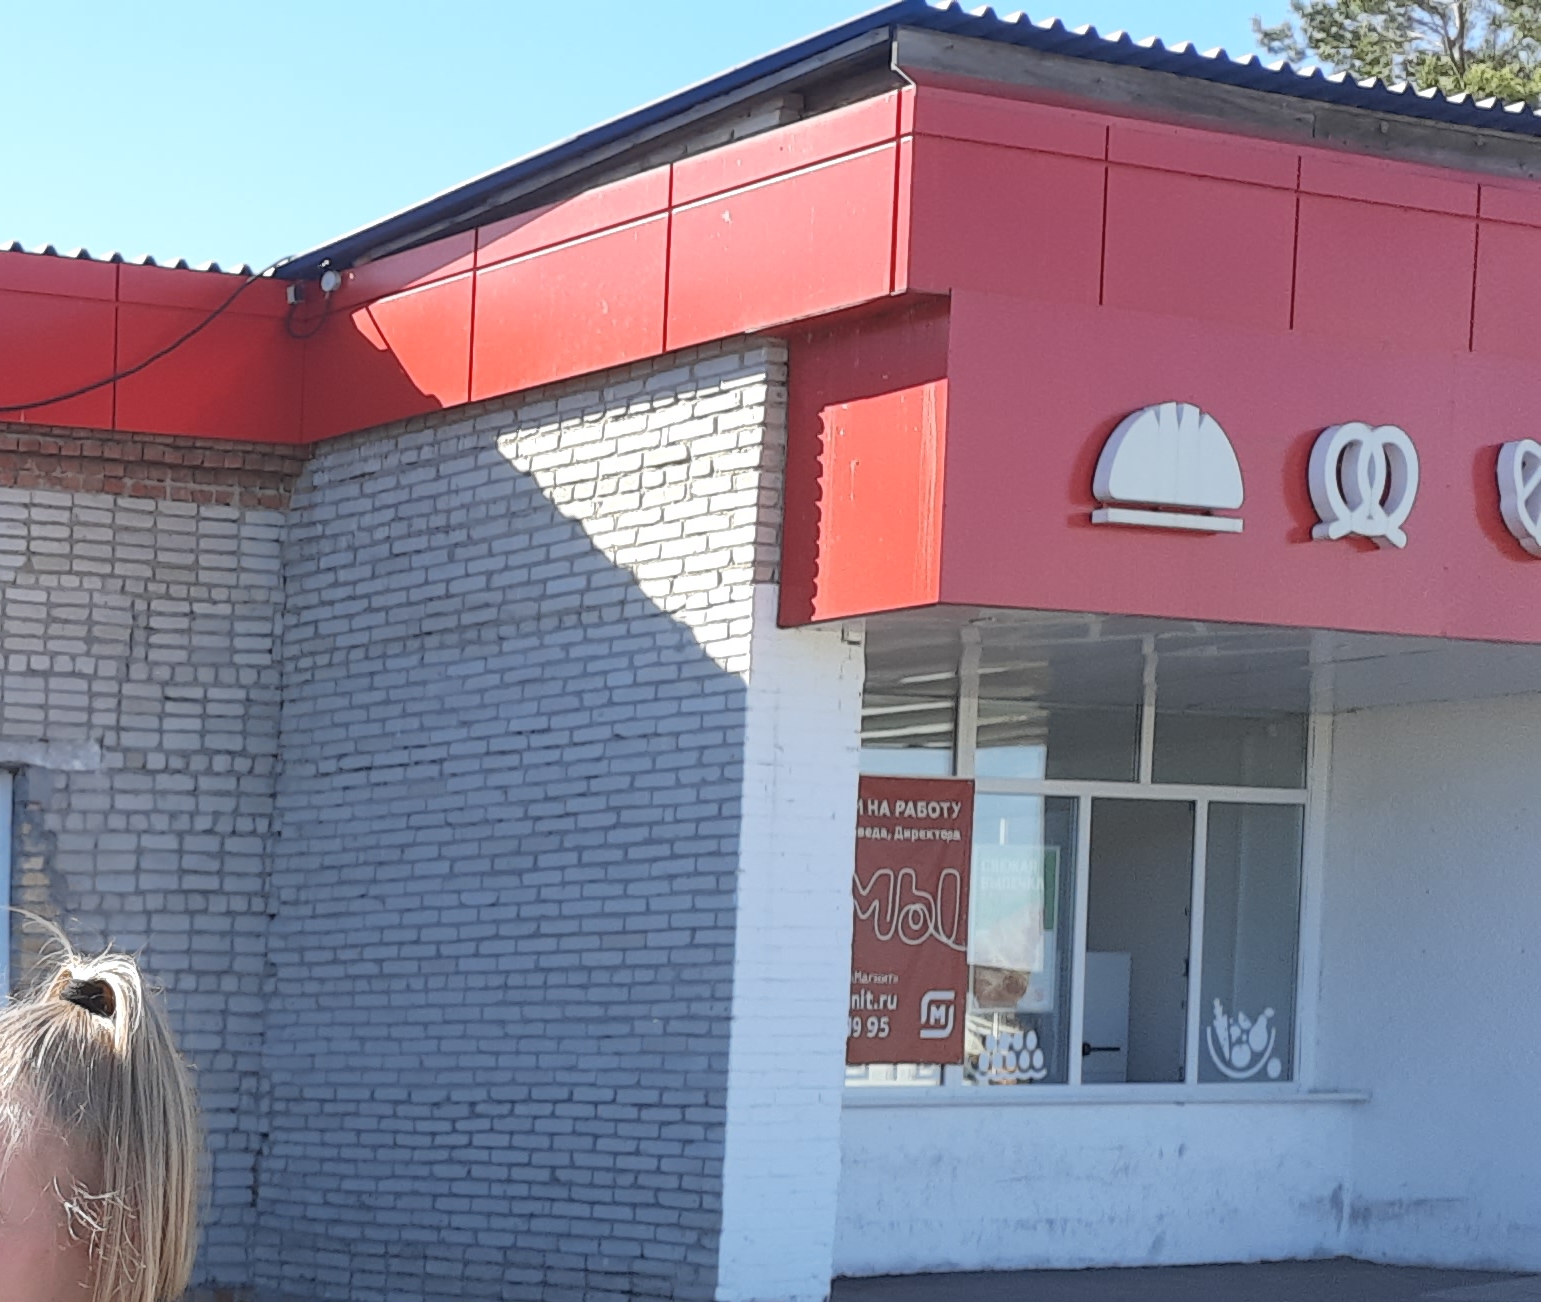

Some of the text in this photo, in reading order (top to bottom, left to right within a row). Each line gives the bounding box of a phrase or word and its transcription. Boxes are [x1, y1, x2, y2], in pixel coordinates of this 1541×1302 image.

[867, 799, 890, 817] НА
[895, 800, 961, 819] РАБОТУ
[894, 826, 961, 843] Директора
[866, 1015, 890, 1039] 95
